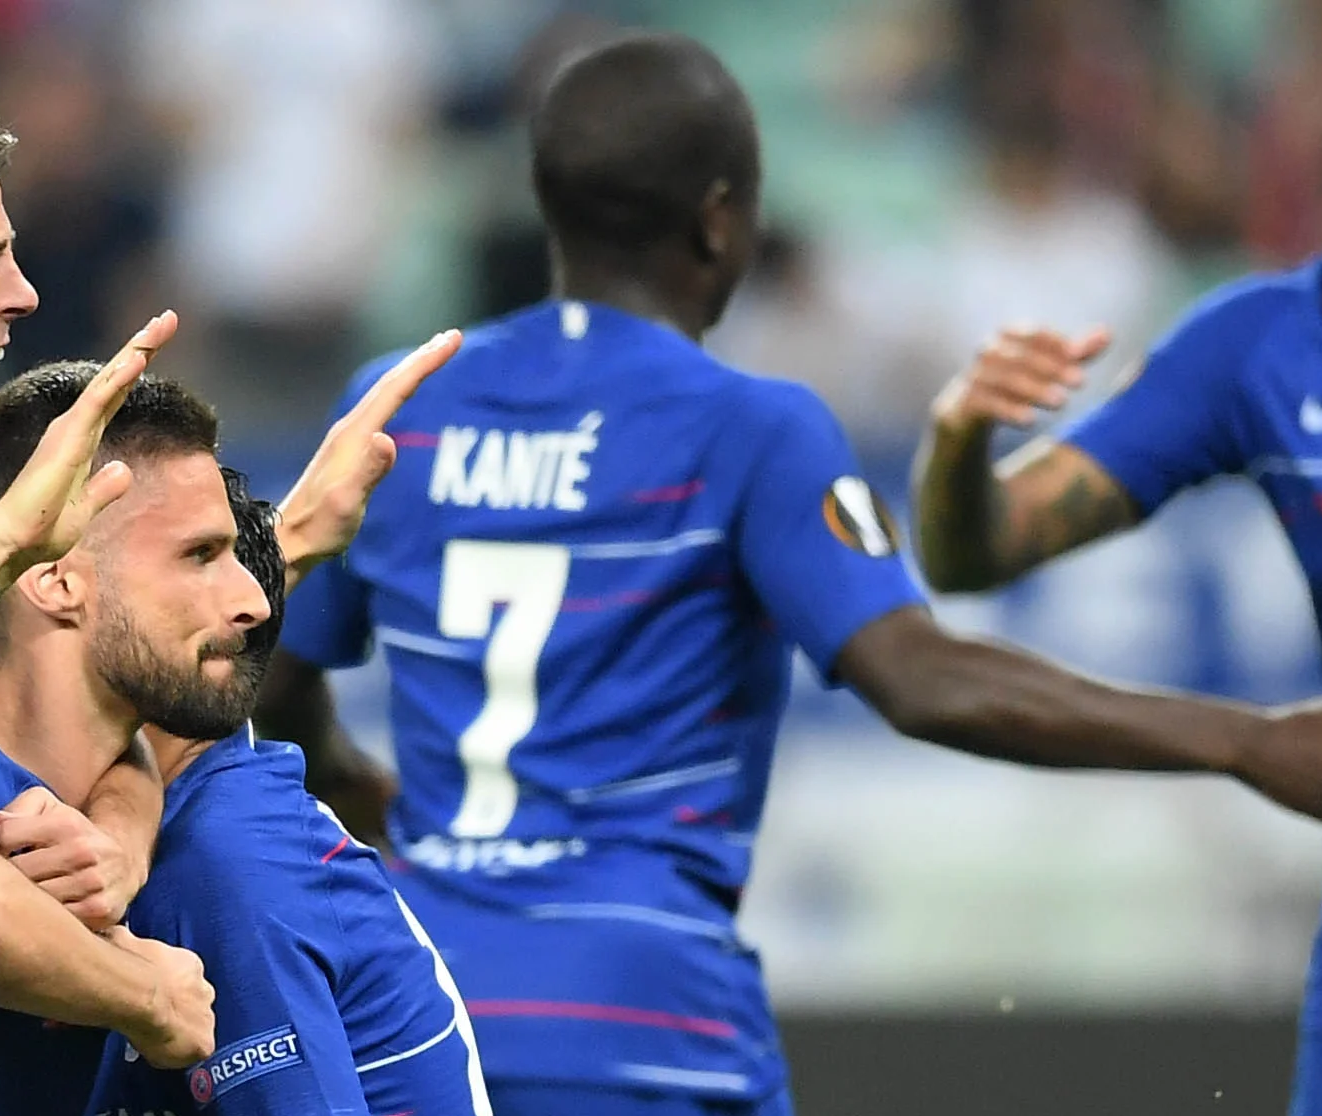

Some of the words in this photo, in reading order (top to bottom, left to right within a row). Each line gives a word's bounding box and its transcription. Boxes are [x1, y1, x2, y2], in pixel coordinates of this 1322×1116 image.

[429, 410, 605, 511] KANTÉ
[438, 538, 572, 838] 7
[211, 1033, 298, 1084] RESPECT
